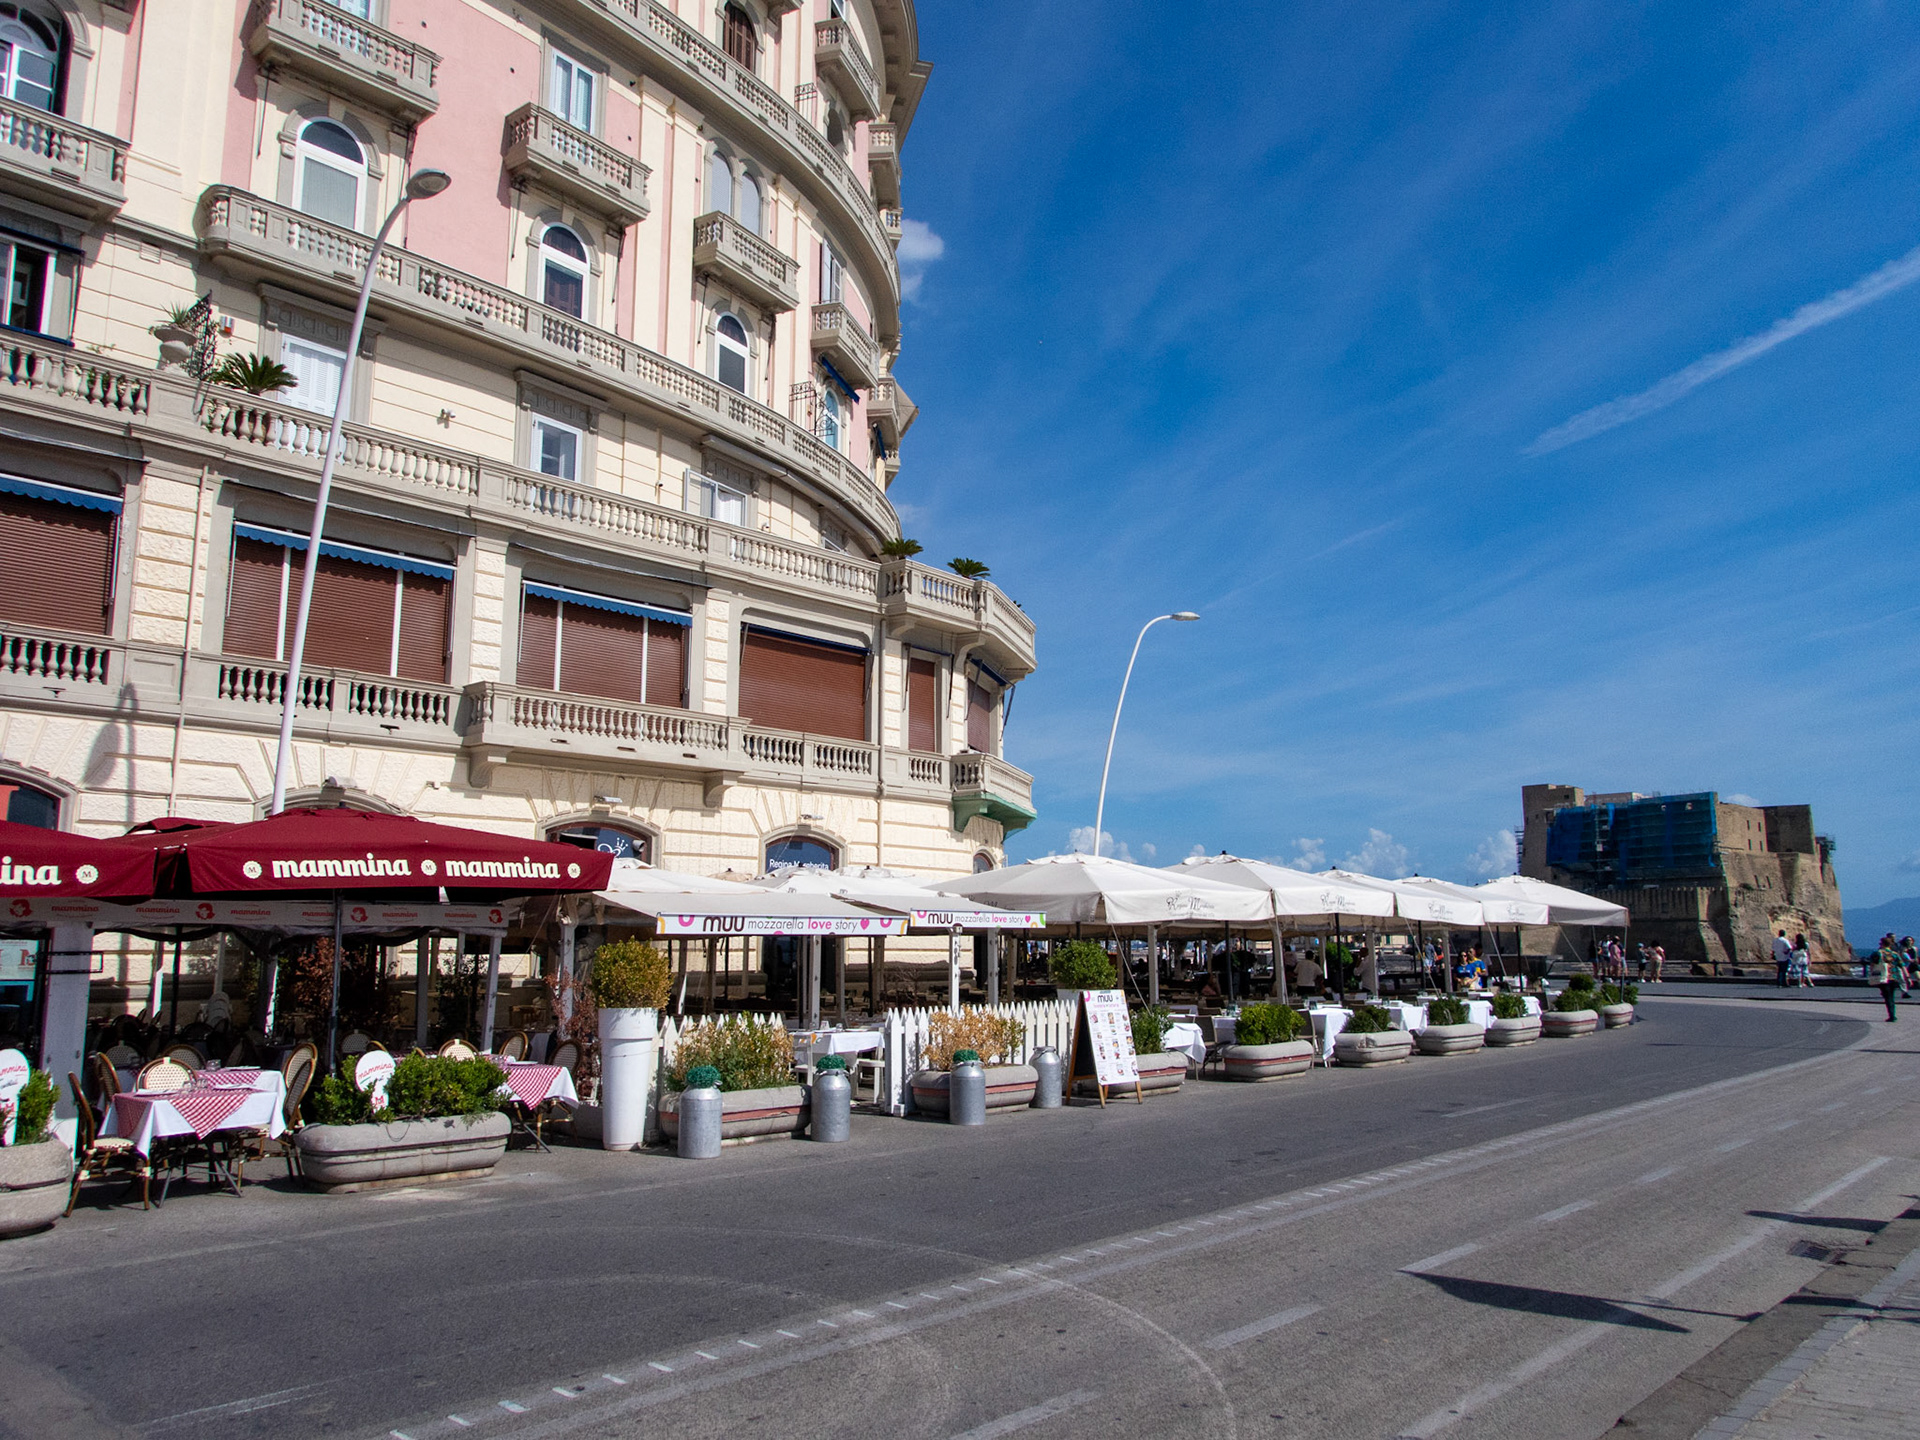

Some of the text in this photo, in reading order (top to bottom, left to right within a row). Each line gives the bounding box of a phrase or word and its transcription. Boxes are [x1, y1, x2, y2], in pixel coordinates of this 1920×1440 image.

[0, 856, 62, 885] ina
[272, 852, 412, 878] mammina
[445, 856, 561, 878] mammina
[769, 858, 792, 869] Regina
[748, 917, 804, 930] mozzarella
[807, 917, 832, 930] love
[835, 917, 858, 933] story
[955, 913, 990, 923] mozzarella
[991, 913, 1007, 923] love
[1009, 914, 1024, 925] story
